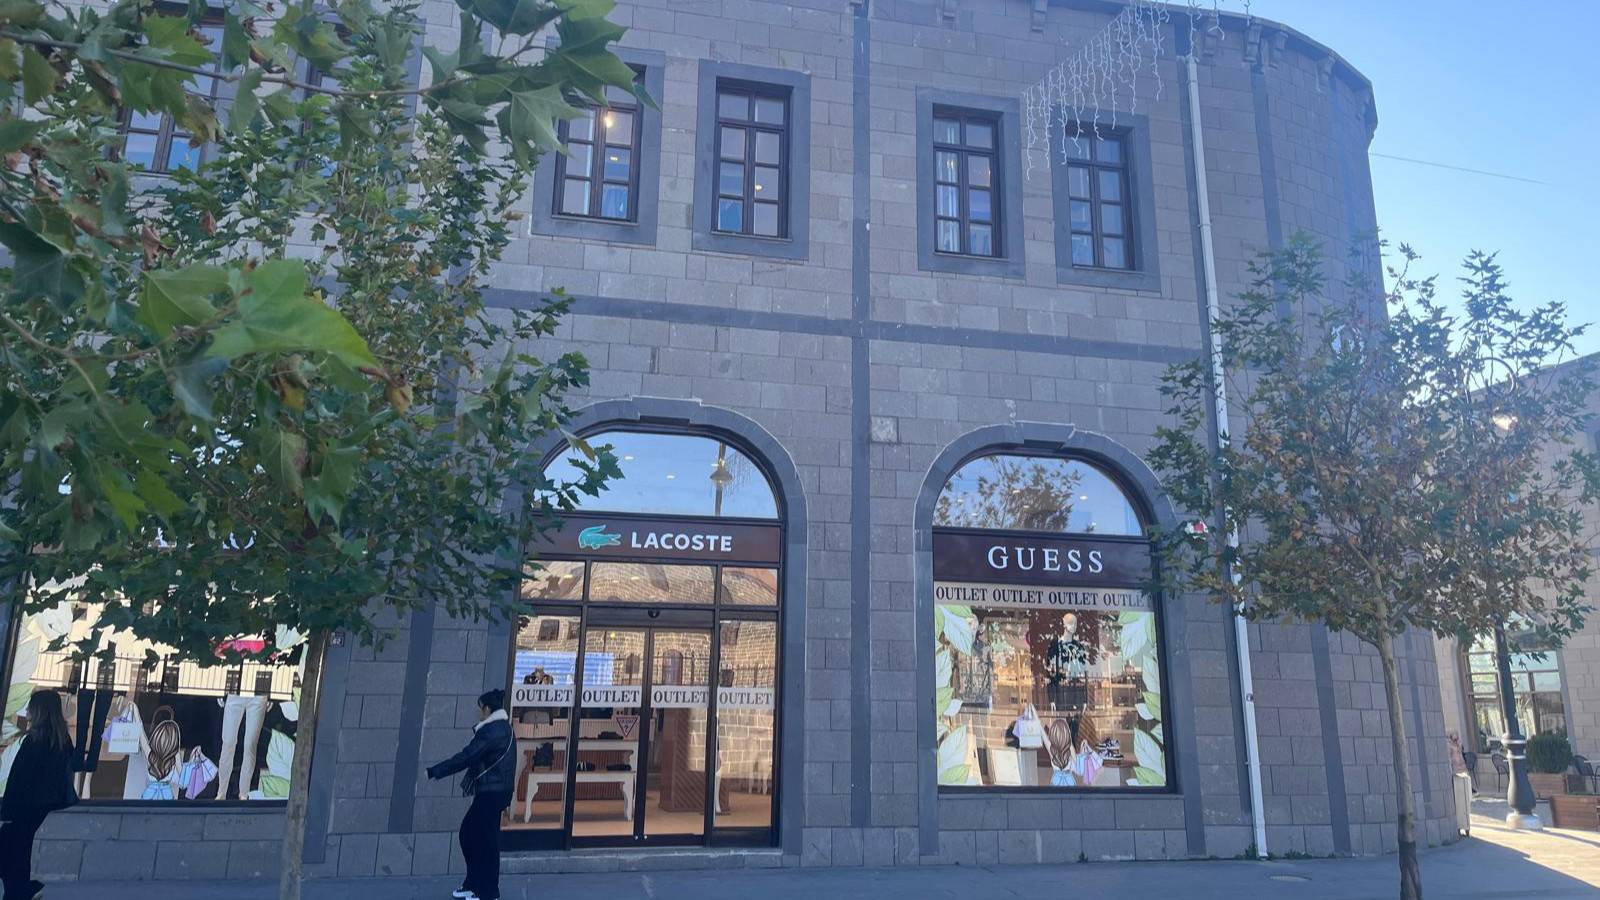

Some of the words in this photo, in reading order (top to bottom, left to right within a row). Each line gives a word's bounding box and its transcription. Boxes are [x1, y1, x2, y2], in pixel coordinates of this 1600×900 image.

[631, 531, 733, 552] LACOSTE
[987, 545, 1103, 573] GUESS
[935, 586, 988, 601] OUTLET
[992, 588, 1044, 604] OUTLET
[1048, 591, 1099, 606] OUTLET
[515, 688, 572, 702] OUTLET
[582, 689, 640, 703] OUTLET
[653, 690, 709, 704] OUTLET
[719, 692, 772, 705] OUTLET
